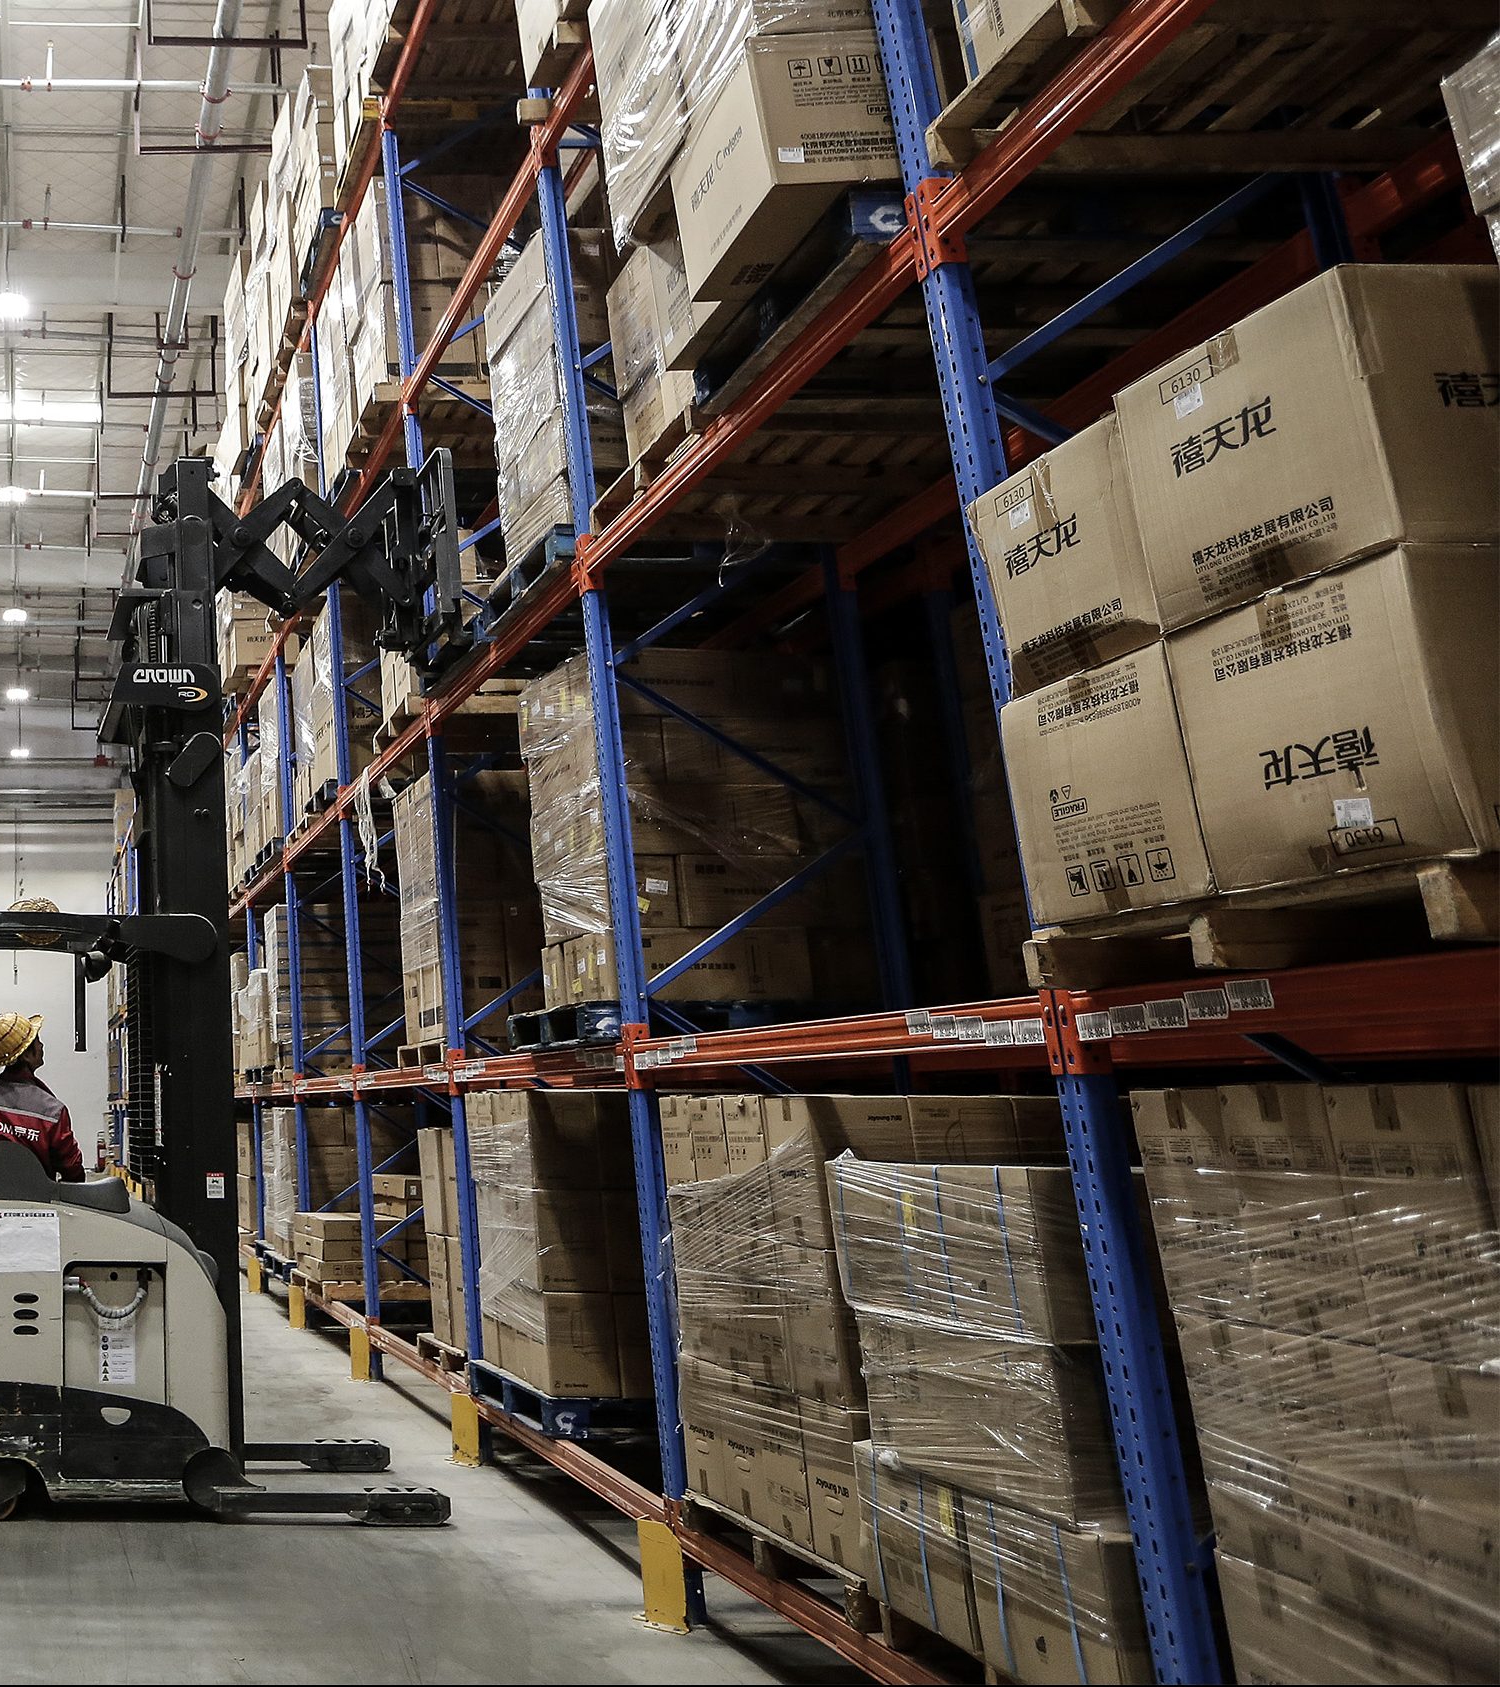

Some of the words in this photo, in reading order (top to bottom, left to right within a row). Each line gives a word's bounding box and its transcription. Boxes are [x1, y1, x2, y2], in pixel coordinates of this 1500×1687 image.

[1171, 367, 1202, 394] 6130
[1169, 396, 1277, 479] 禧天龙
[1003, 486, 1025, 508] 6130
[1003, 513, 1081, 580] 禧天龙
[1192, 496, 1335, 567] 禧天龙科技发展有限公司
[1021, 598, 1123, 654] 禧天龙科技发展有限公司
[132, 668, 196, 684] CROWN
[1214, 623, 1352, 682] 禧天龙科技发展有限公司
[1037, 679, 1140, 727] 禧天龙科技发展有限公司
[1259, 726, 1380, 791] 禧天龙
[1053, 801, 1086, 818] FRAGILE
[1345, 826, 1384, 848] 6130
